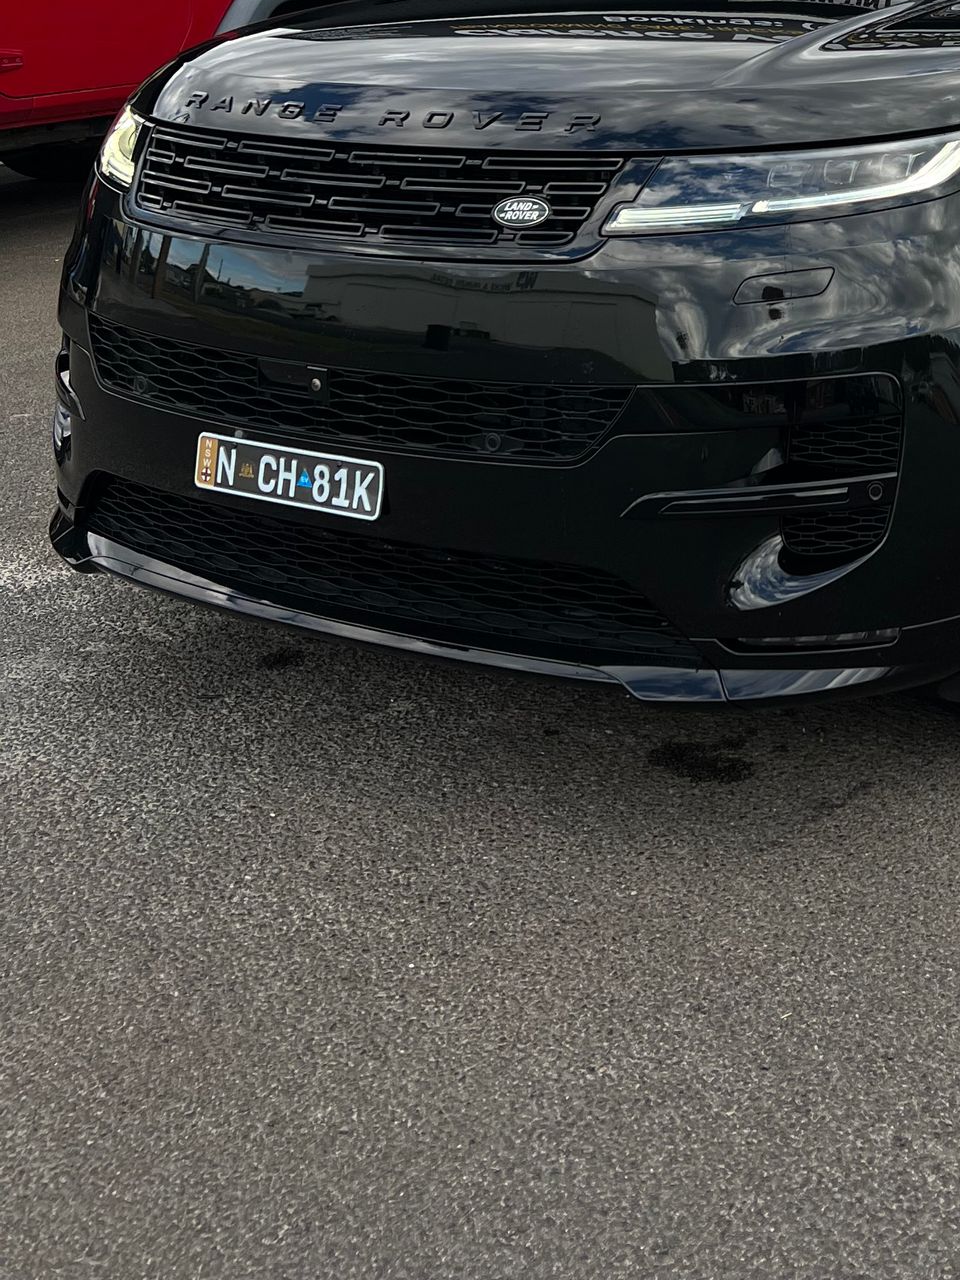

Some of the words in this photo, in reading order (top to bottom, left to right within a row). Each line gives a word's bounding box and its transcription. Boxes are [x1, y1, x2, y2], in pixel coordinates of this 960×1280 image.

[185, 91, 344, 124] RANGE
[378, 109, 602, 133] ROVER
[503, 202, 533, 211] LAND
[504, 211, 540, 221] ROVER
[202, 439, 214, 468] NSW
